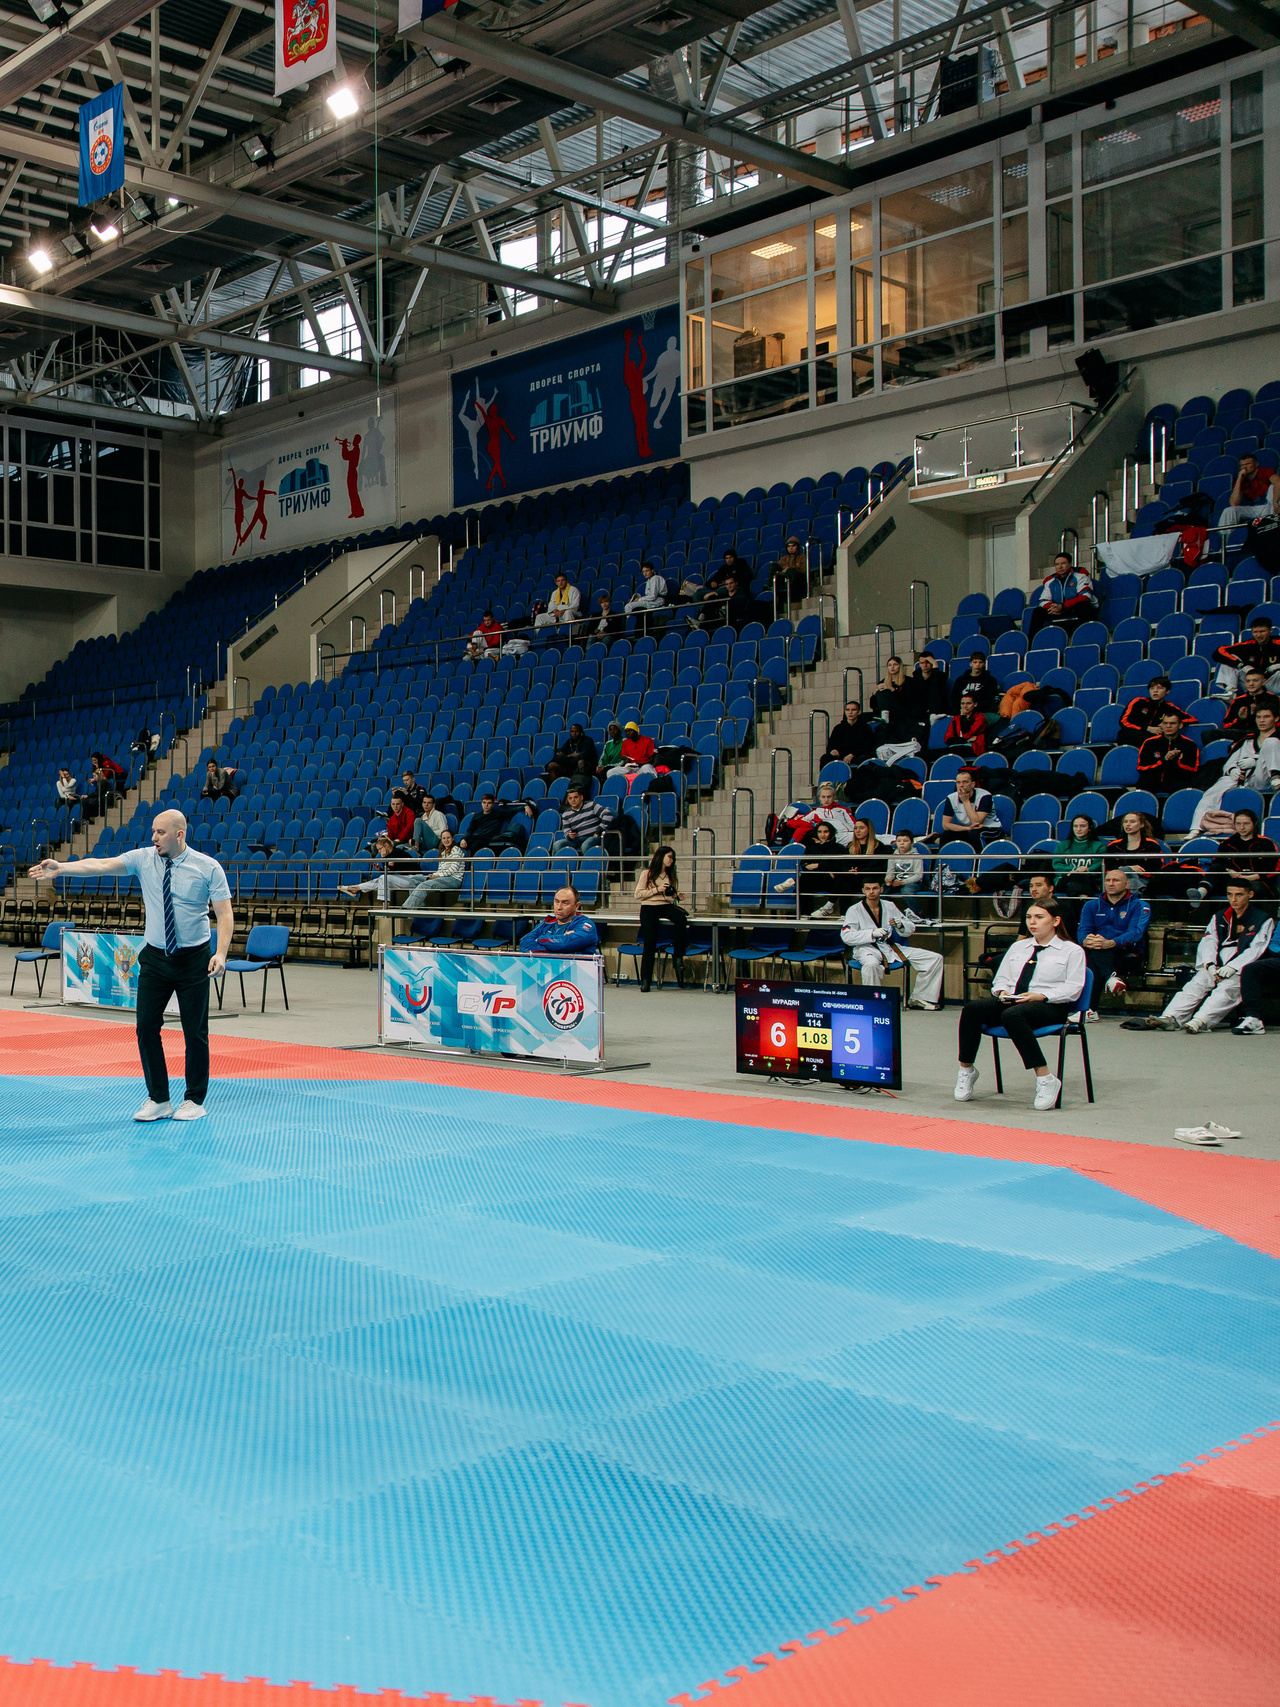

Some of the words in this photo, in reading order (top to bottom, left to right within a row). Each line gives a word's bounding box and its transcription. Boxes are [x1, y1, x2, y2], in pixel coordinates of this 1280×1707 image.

[529, 374, 563, 393] ДВОРЕЦ
[568, 363, 601, 380] СПОРТА
[530, 415, 603, 454] ТРИУМФ
[278, 451, 302, 464] ДВОРЕЦ
[306, 443, 330, 456] СПОРТА
[279, 487, 331, 518] ТРИУМФ
[772, 998, 800, 1006] МУРАДЯН
[822, 1002, 864, 1011] ОВЧИННИКОВ
[743, 1007, 758, 1015] RUS
[807, 1019, 822, 1027] 114
[873, 1017, 890, 1025] RUS
[770, 1022, 787, 1047] 6
[801, 1032, 828, 1045] 1.03
[844, 1028, 861, 1054] 5
